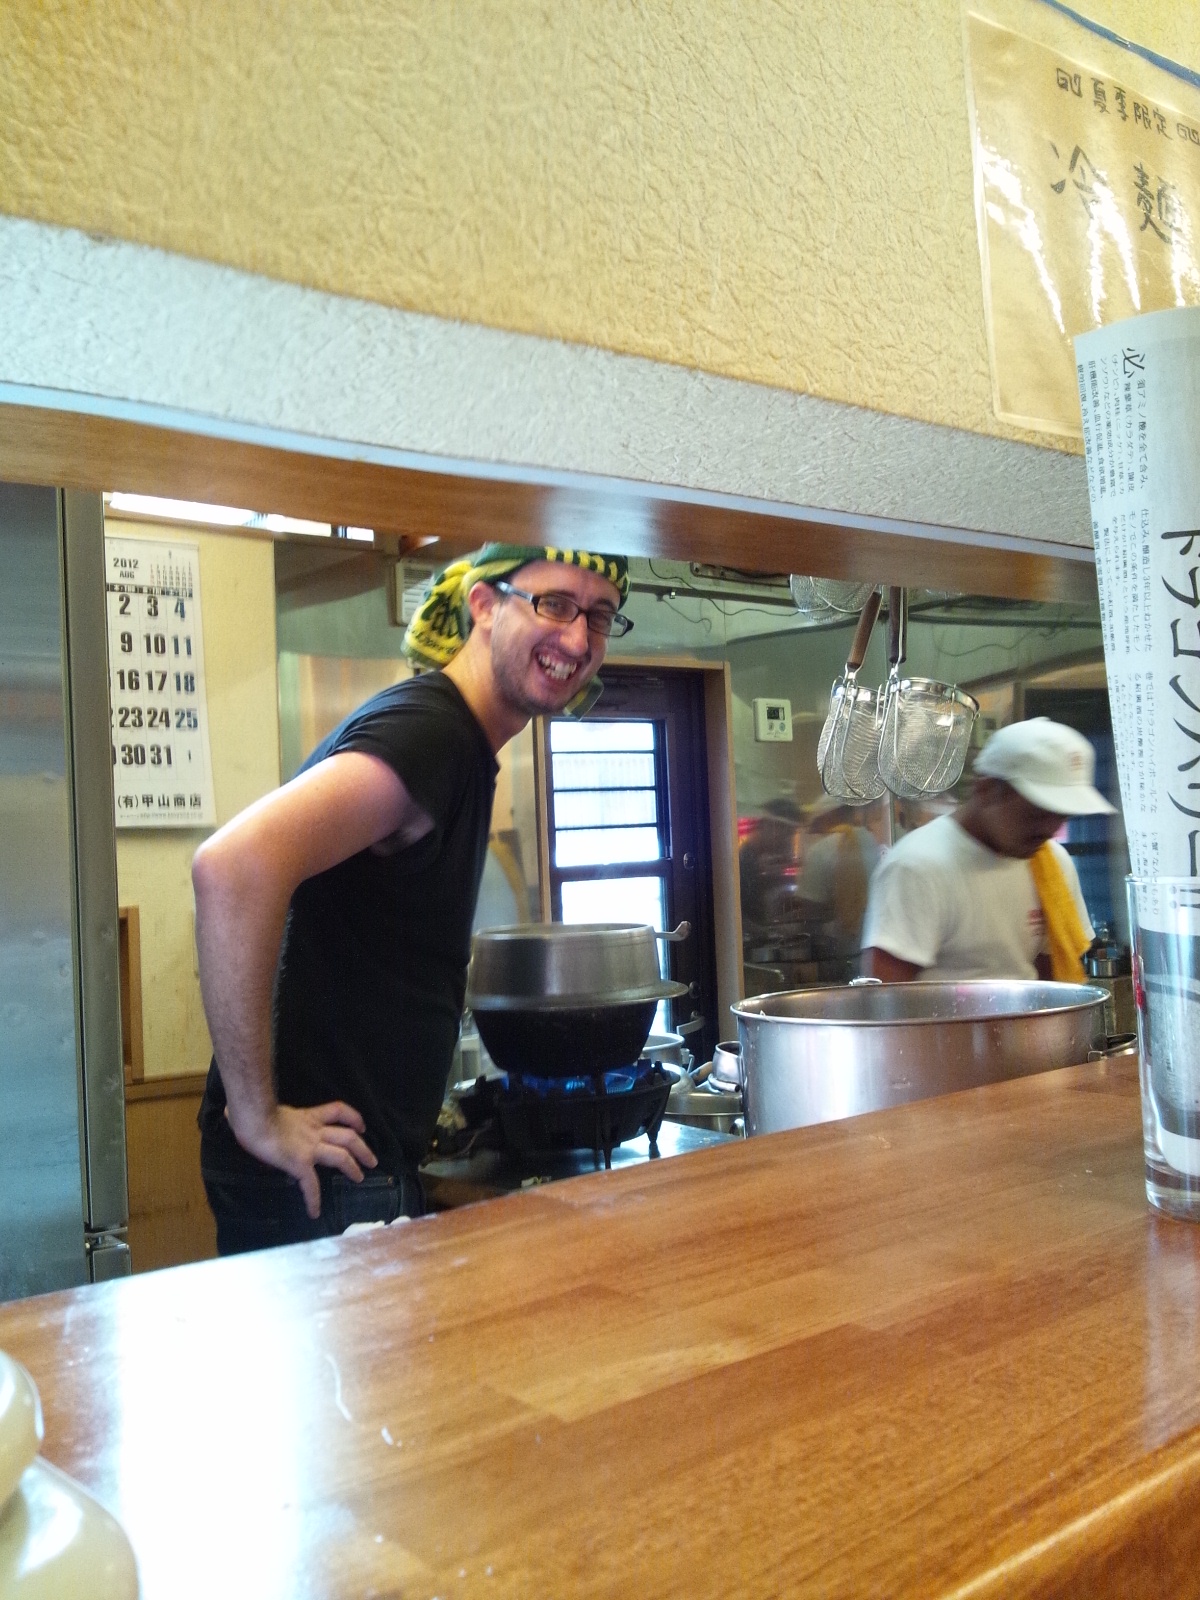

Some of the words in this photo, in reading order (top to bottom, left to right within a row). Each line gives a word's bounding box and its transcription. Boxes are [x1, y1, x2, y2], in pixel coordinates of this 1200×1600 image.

[1121, 347, 1146, 379] 必
[113, 557, 139, 569] 2012
[119, 570, 135, 579] AUG
[118, 593, 131, 616] 2
[146, 594, 159, 618] 3
[174, 597, 186, 620] 4
[120, 631, 133, 653] 9
[143, 632, 166, 655] 10
[171, 633, 192, 656] 11
[117, 668, 140, 691] 16
[145, 669, 168, 692] 17
[174, 670, 196, 693] 18
[118, 706, 143, 728] 23
[147, 707, 170, 729] 24
[174, 707, 198, 730] 25
[121, 743, 145, 765] 30
[150, 744, 172, 766] 31
